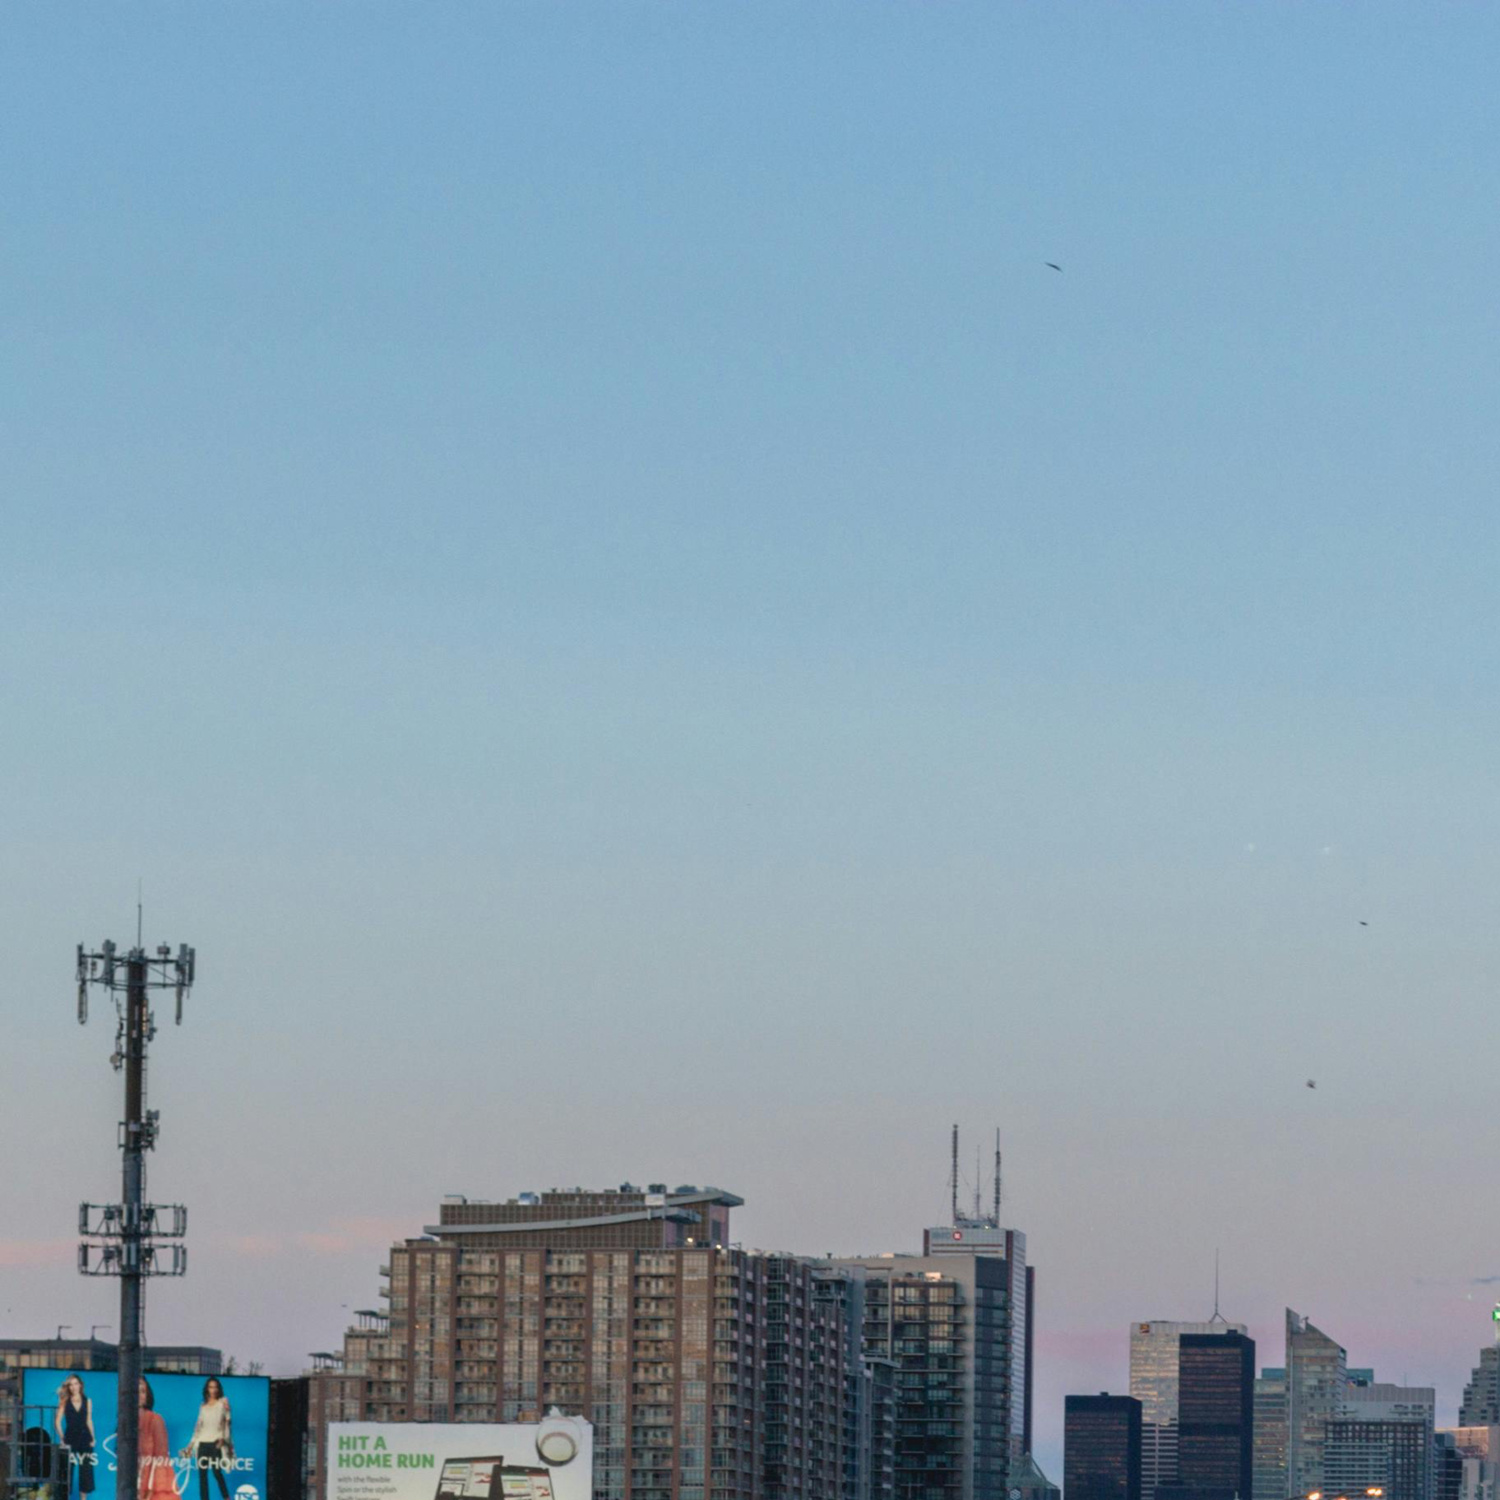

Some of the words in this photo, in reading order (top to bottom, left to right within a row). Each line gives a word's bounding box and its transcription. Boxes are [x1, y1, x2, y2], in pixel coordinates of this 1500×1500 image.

[338, 1435, 369, 1451] HIT
[373, 1436, 387, 1451] A
[197, 1455, 254, 1471] CHOICE
[338, 1454, 392, 1468] HOME
[396, 1454, 435, 1469] RUN
[337, 1475, 353, 1483] with
[354, 1475, 365, 1483] the
[362, 1485, 374, 1493] the
